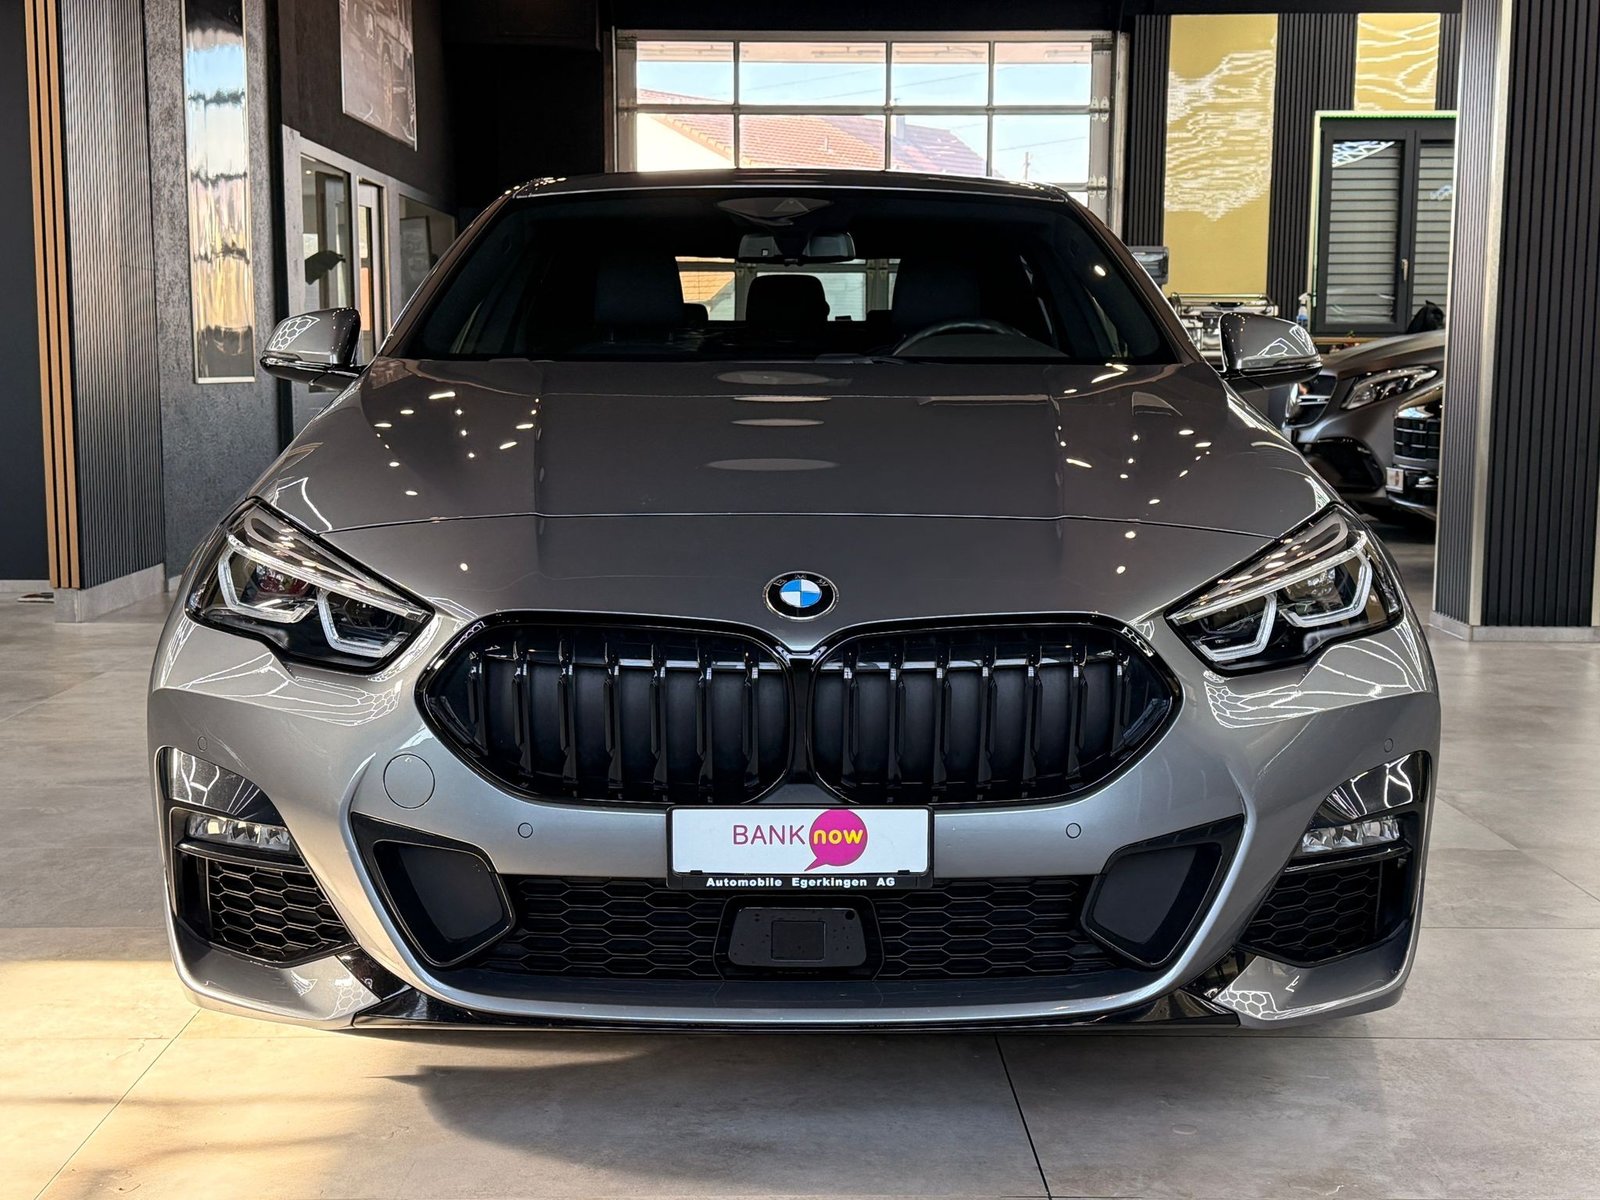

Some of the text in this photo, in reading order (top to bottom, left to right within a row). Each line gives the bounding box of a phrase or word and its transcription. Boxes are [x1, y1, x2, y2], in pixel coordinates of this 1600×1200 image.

[732, 824, 864, 846] BANK now
[706, 877, 896, 888] Automobile Egerkingen AG
